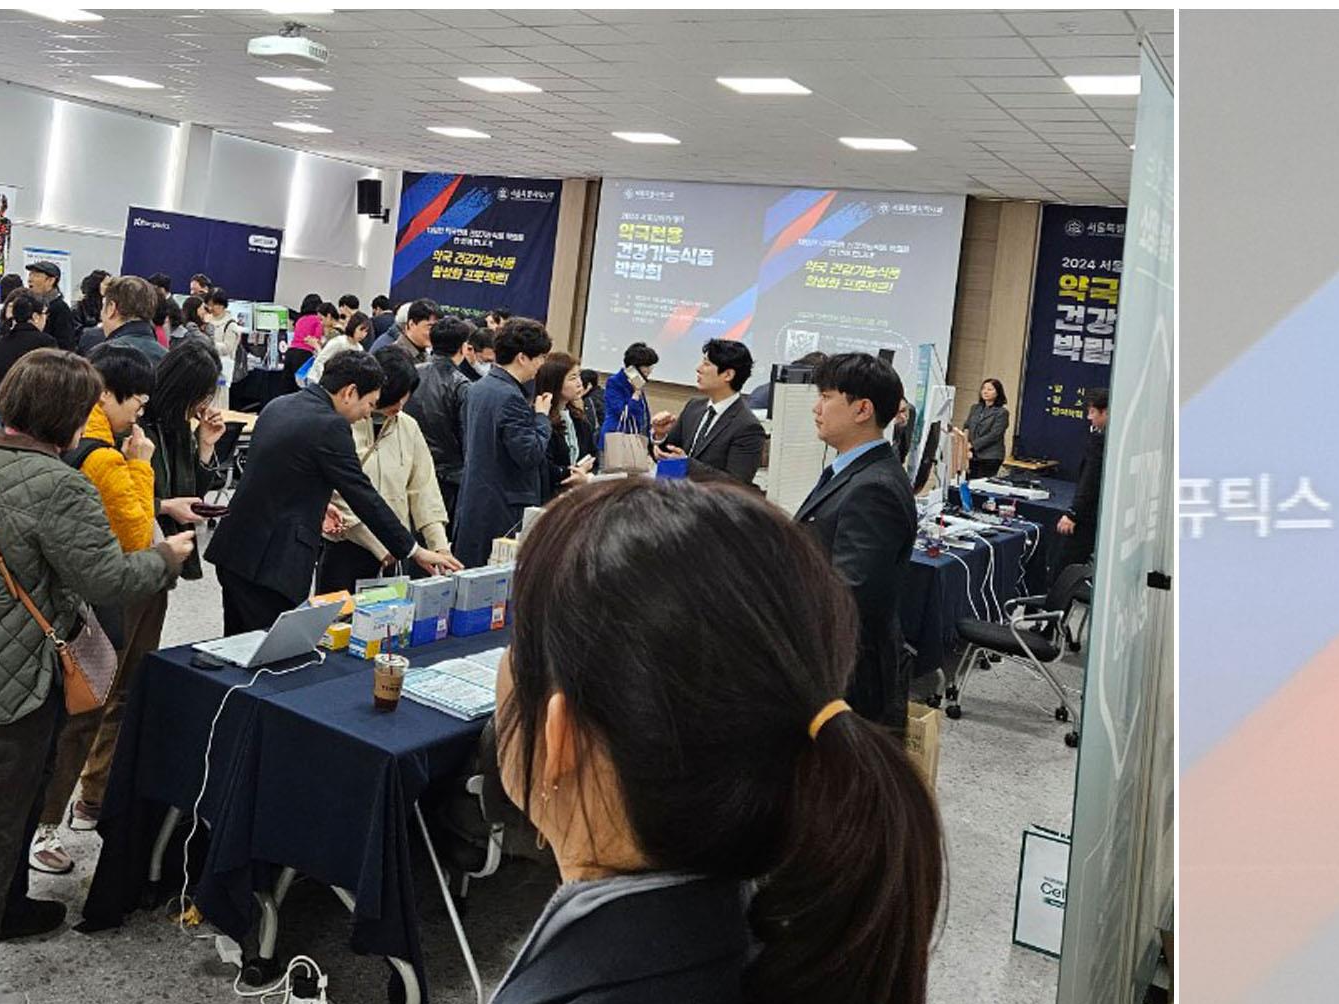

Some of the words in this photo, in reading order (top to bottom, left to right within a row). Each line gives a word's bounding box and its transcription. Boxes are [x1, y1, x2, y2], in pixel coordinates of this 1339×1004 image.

[619, 223, 684, 244] 약국전용
[617, 242, 714, 267] 건강기능식품
[1062, 257, 1096, 269] 2024
[1058, 274, 1119, 304] 약국
[1055, 304, 1117, 334] 건강
[1052, 334, 1114, 364] 박람
[1179, 472, 1334, 539] 퓨틱스
